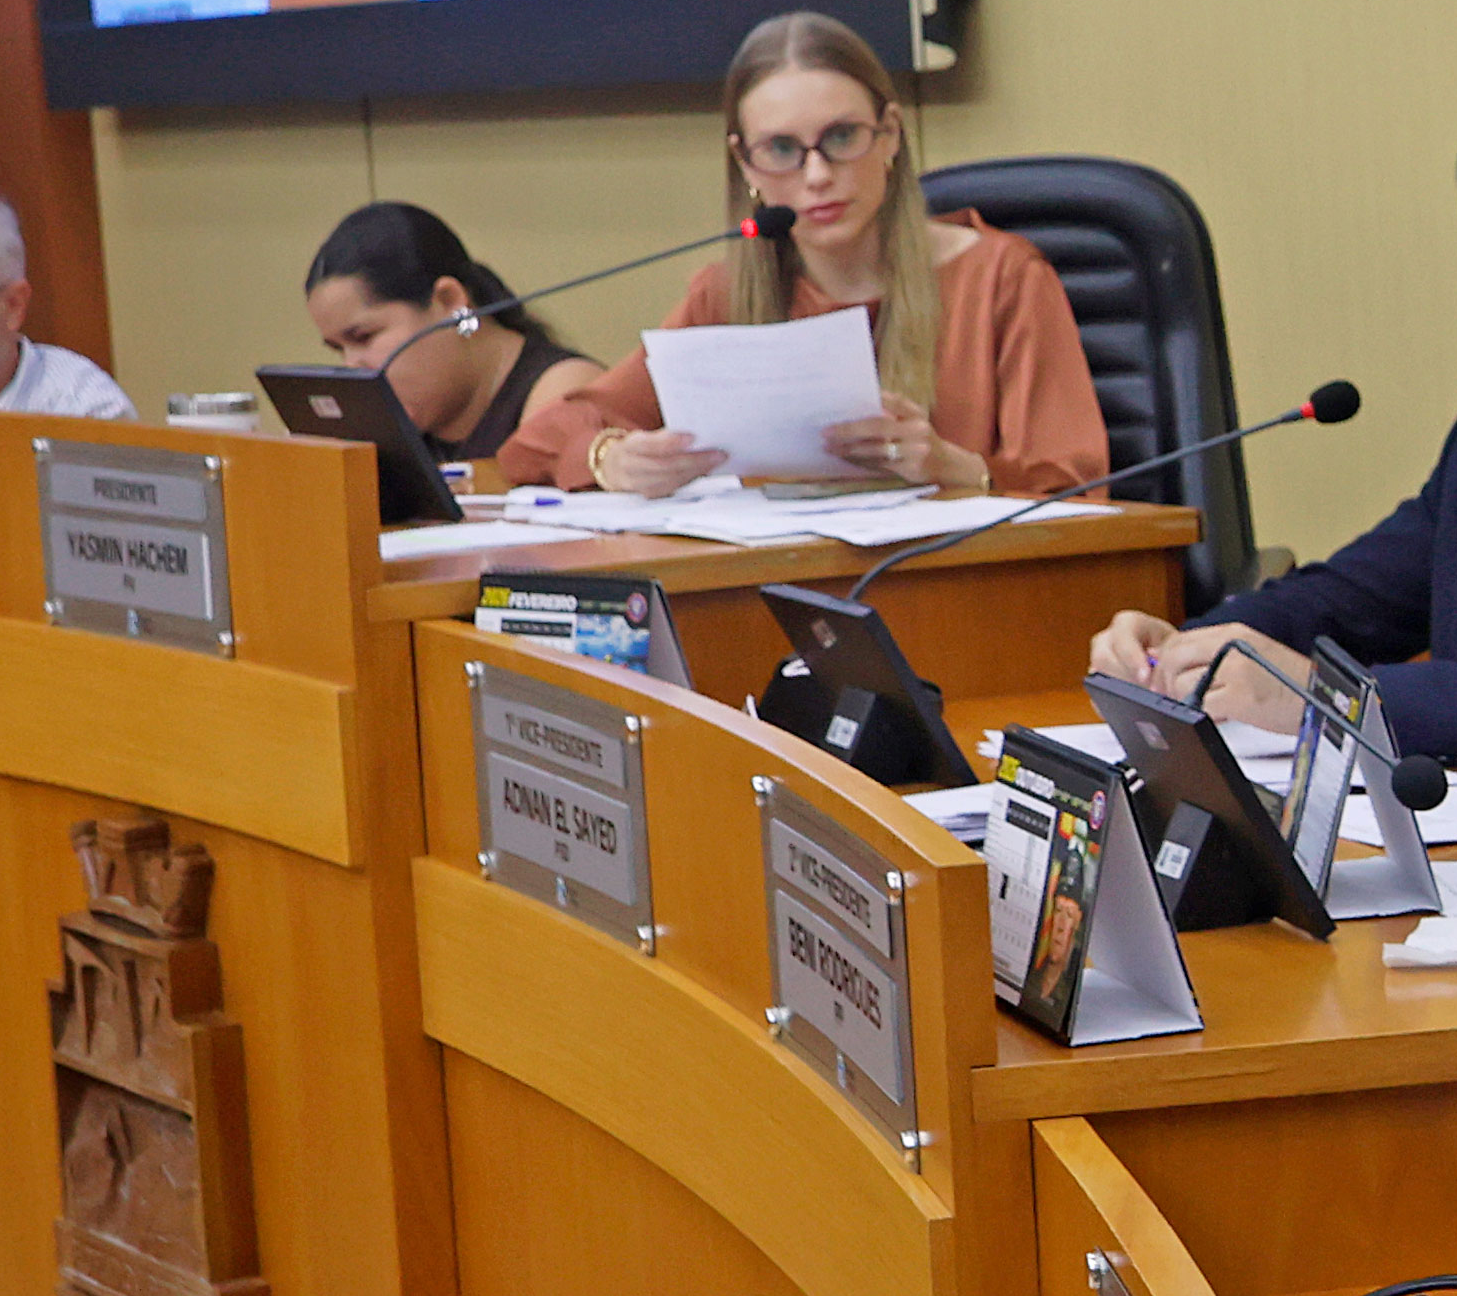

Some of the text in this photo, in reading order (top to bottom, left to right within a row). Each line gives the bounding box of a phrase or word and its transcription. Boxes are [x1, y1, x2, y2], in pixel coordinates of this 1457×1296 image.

[66, 531, 189, 574] YASMIN HACHEM
[503, 777, 618, 855] ADNAN EL SAYED
